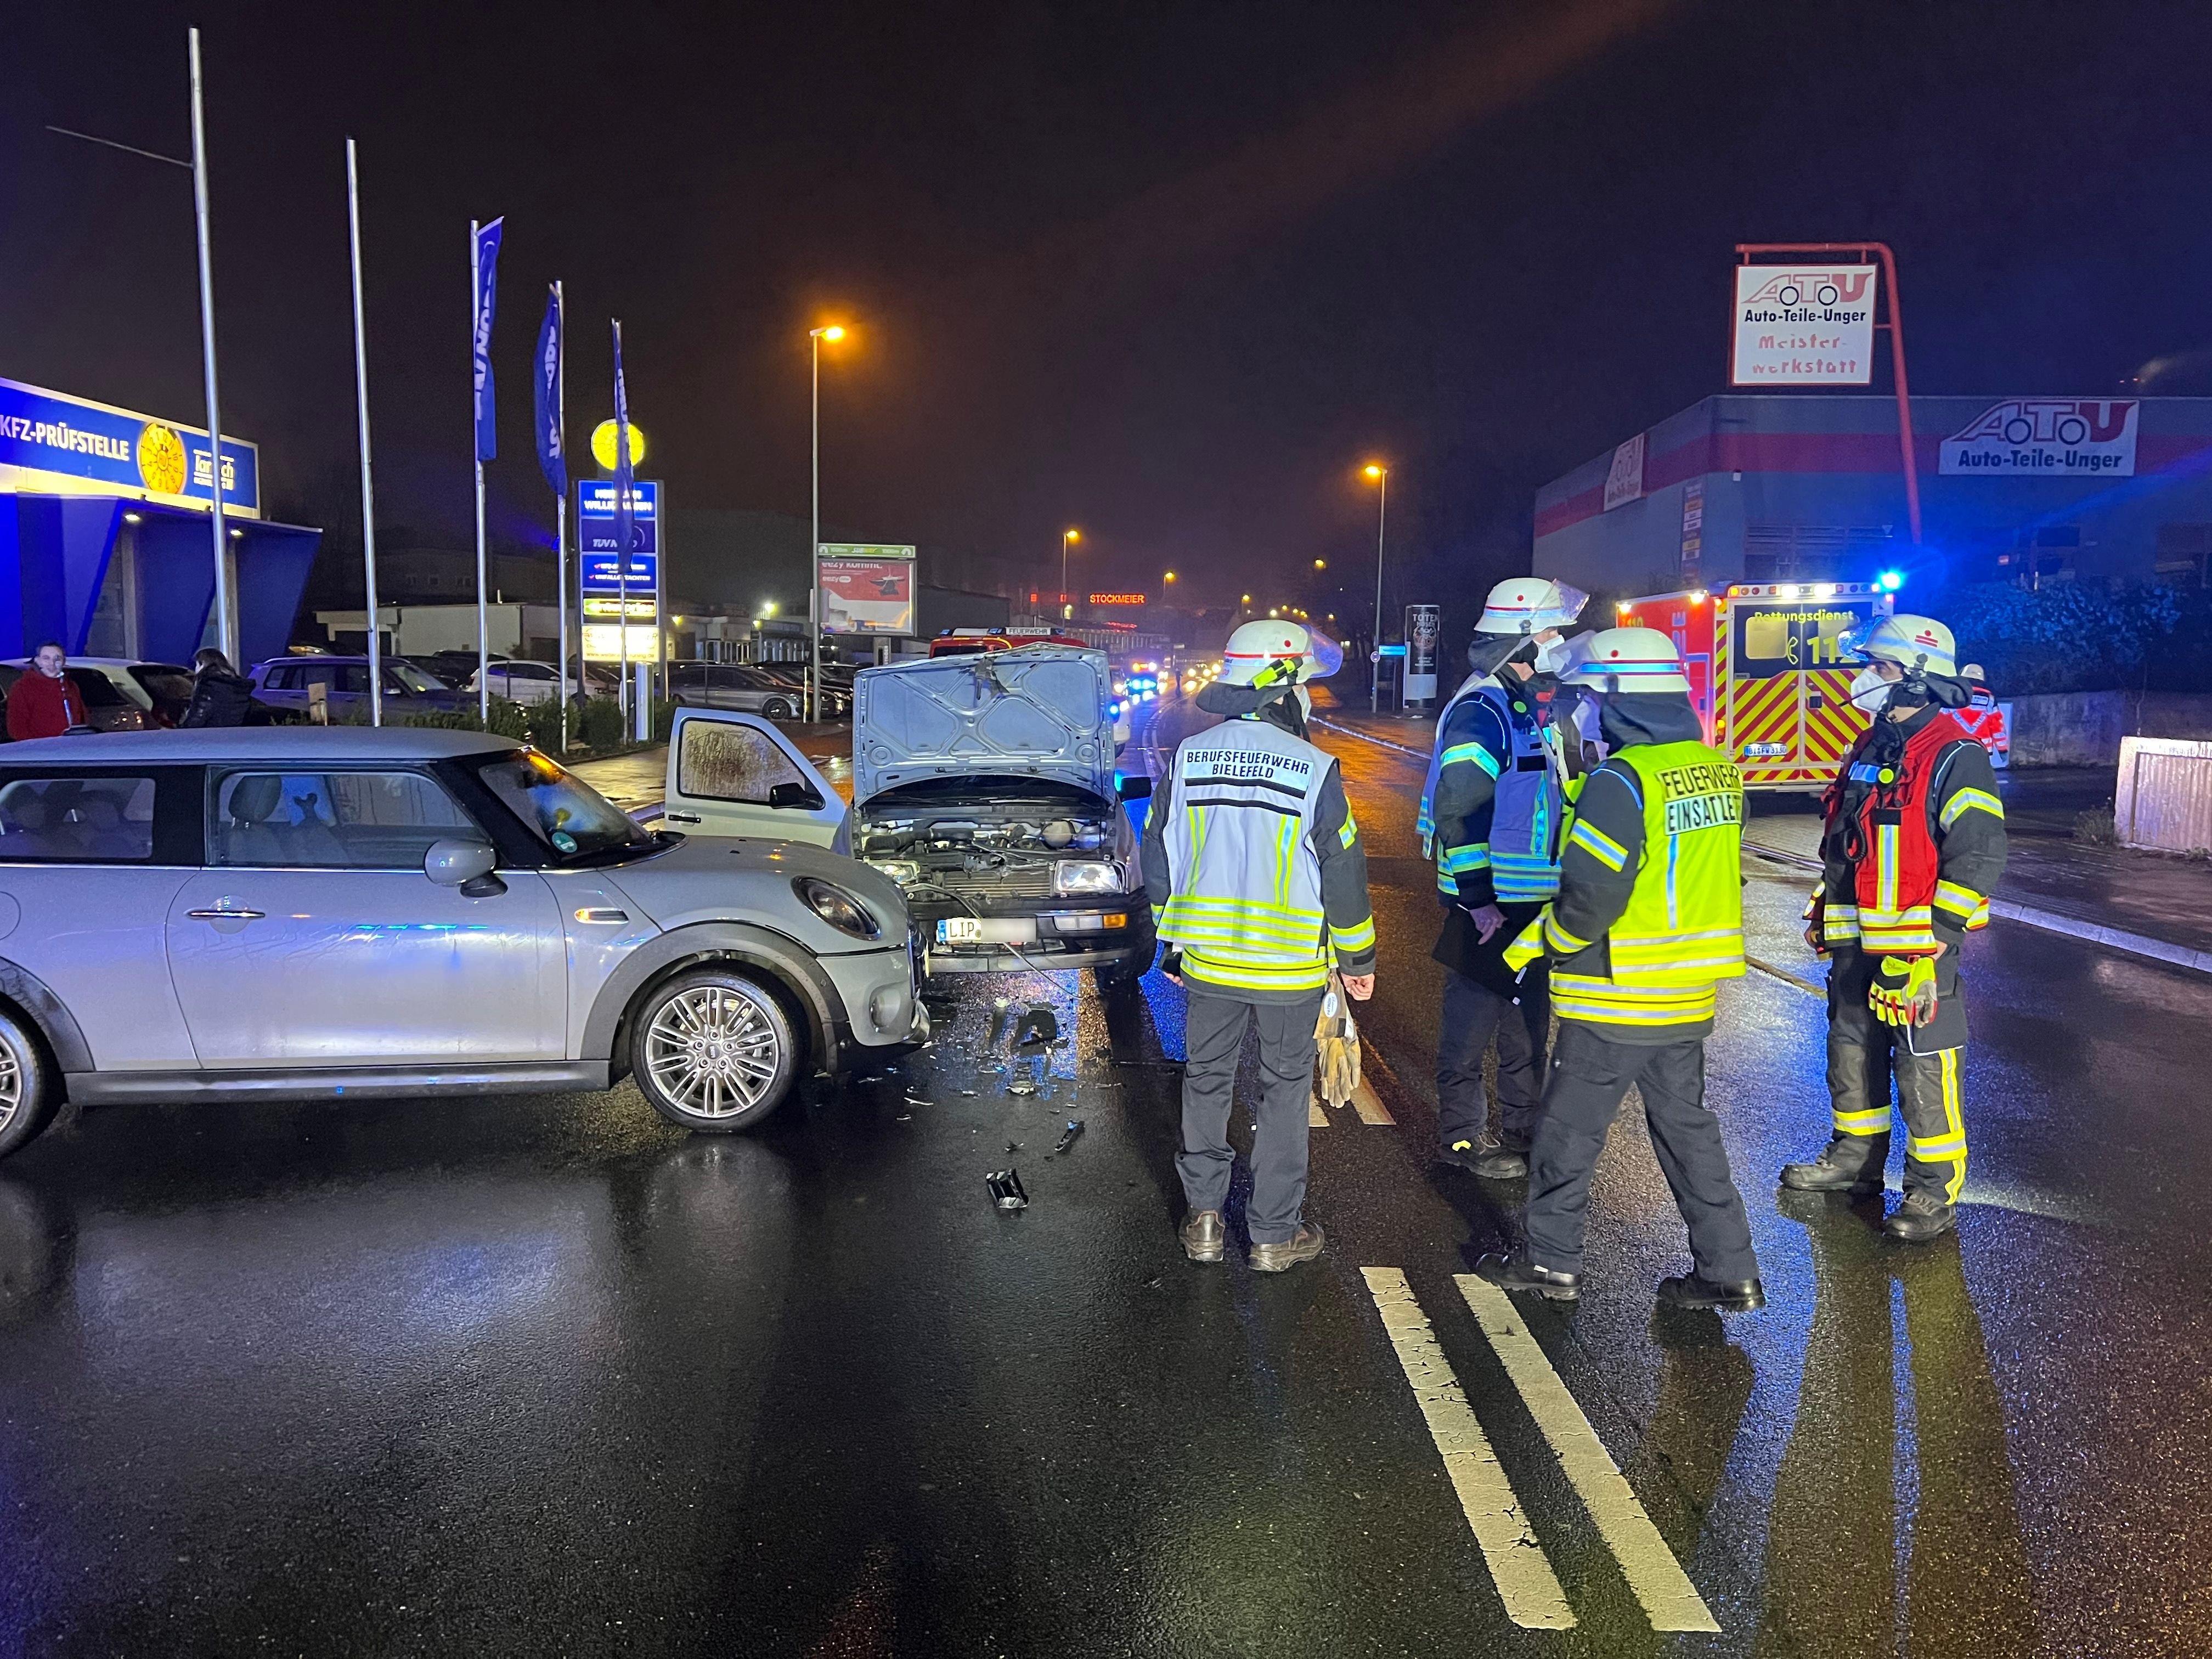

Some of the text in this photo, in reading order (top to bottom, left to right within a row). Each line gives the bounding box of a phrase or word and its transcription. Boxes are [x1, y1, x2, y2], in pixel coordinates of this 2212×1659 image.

[1744, 308, 1866, 324] Auto-Teile-Unger
[0, 414, 130, 461] KFZ-PRÜFSTELLE
[1958, 448, 2123, 471] Auto-Teile-Unger
[1090, 593, 1146, 603] STOCKMEIER
[1754, 609, 1854, 624] Rettungsdienst
[1187, 751, 1310, 775] BERUFSFEUERWEHR
[1212, 764, 1274, 778] BIELEFELD
[1660, 764, 1741, 798] FEUERWEHR
[950, 922, 974, 937] LIP
